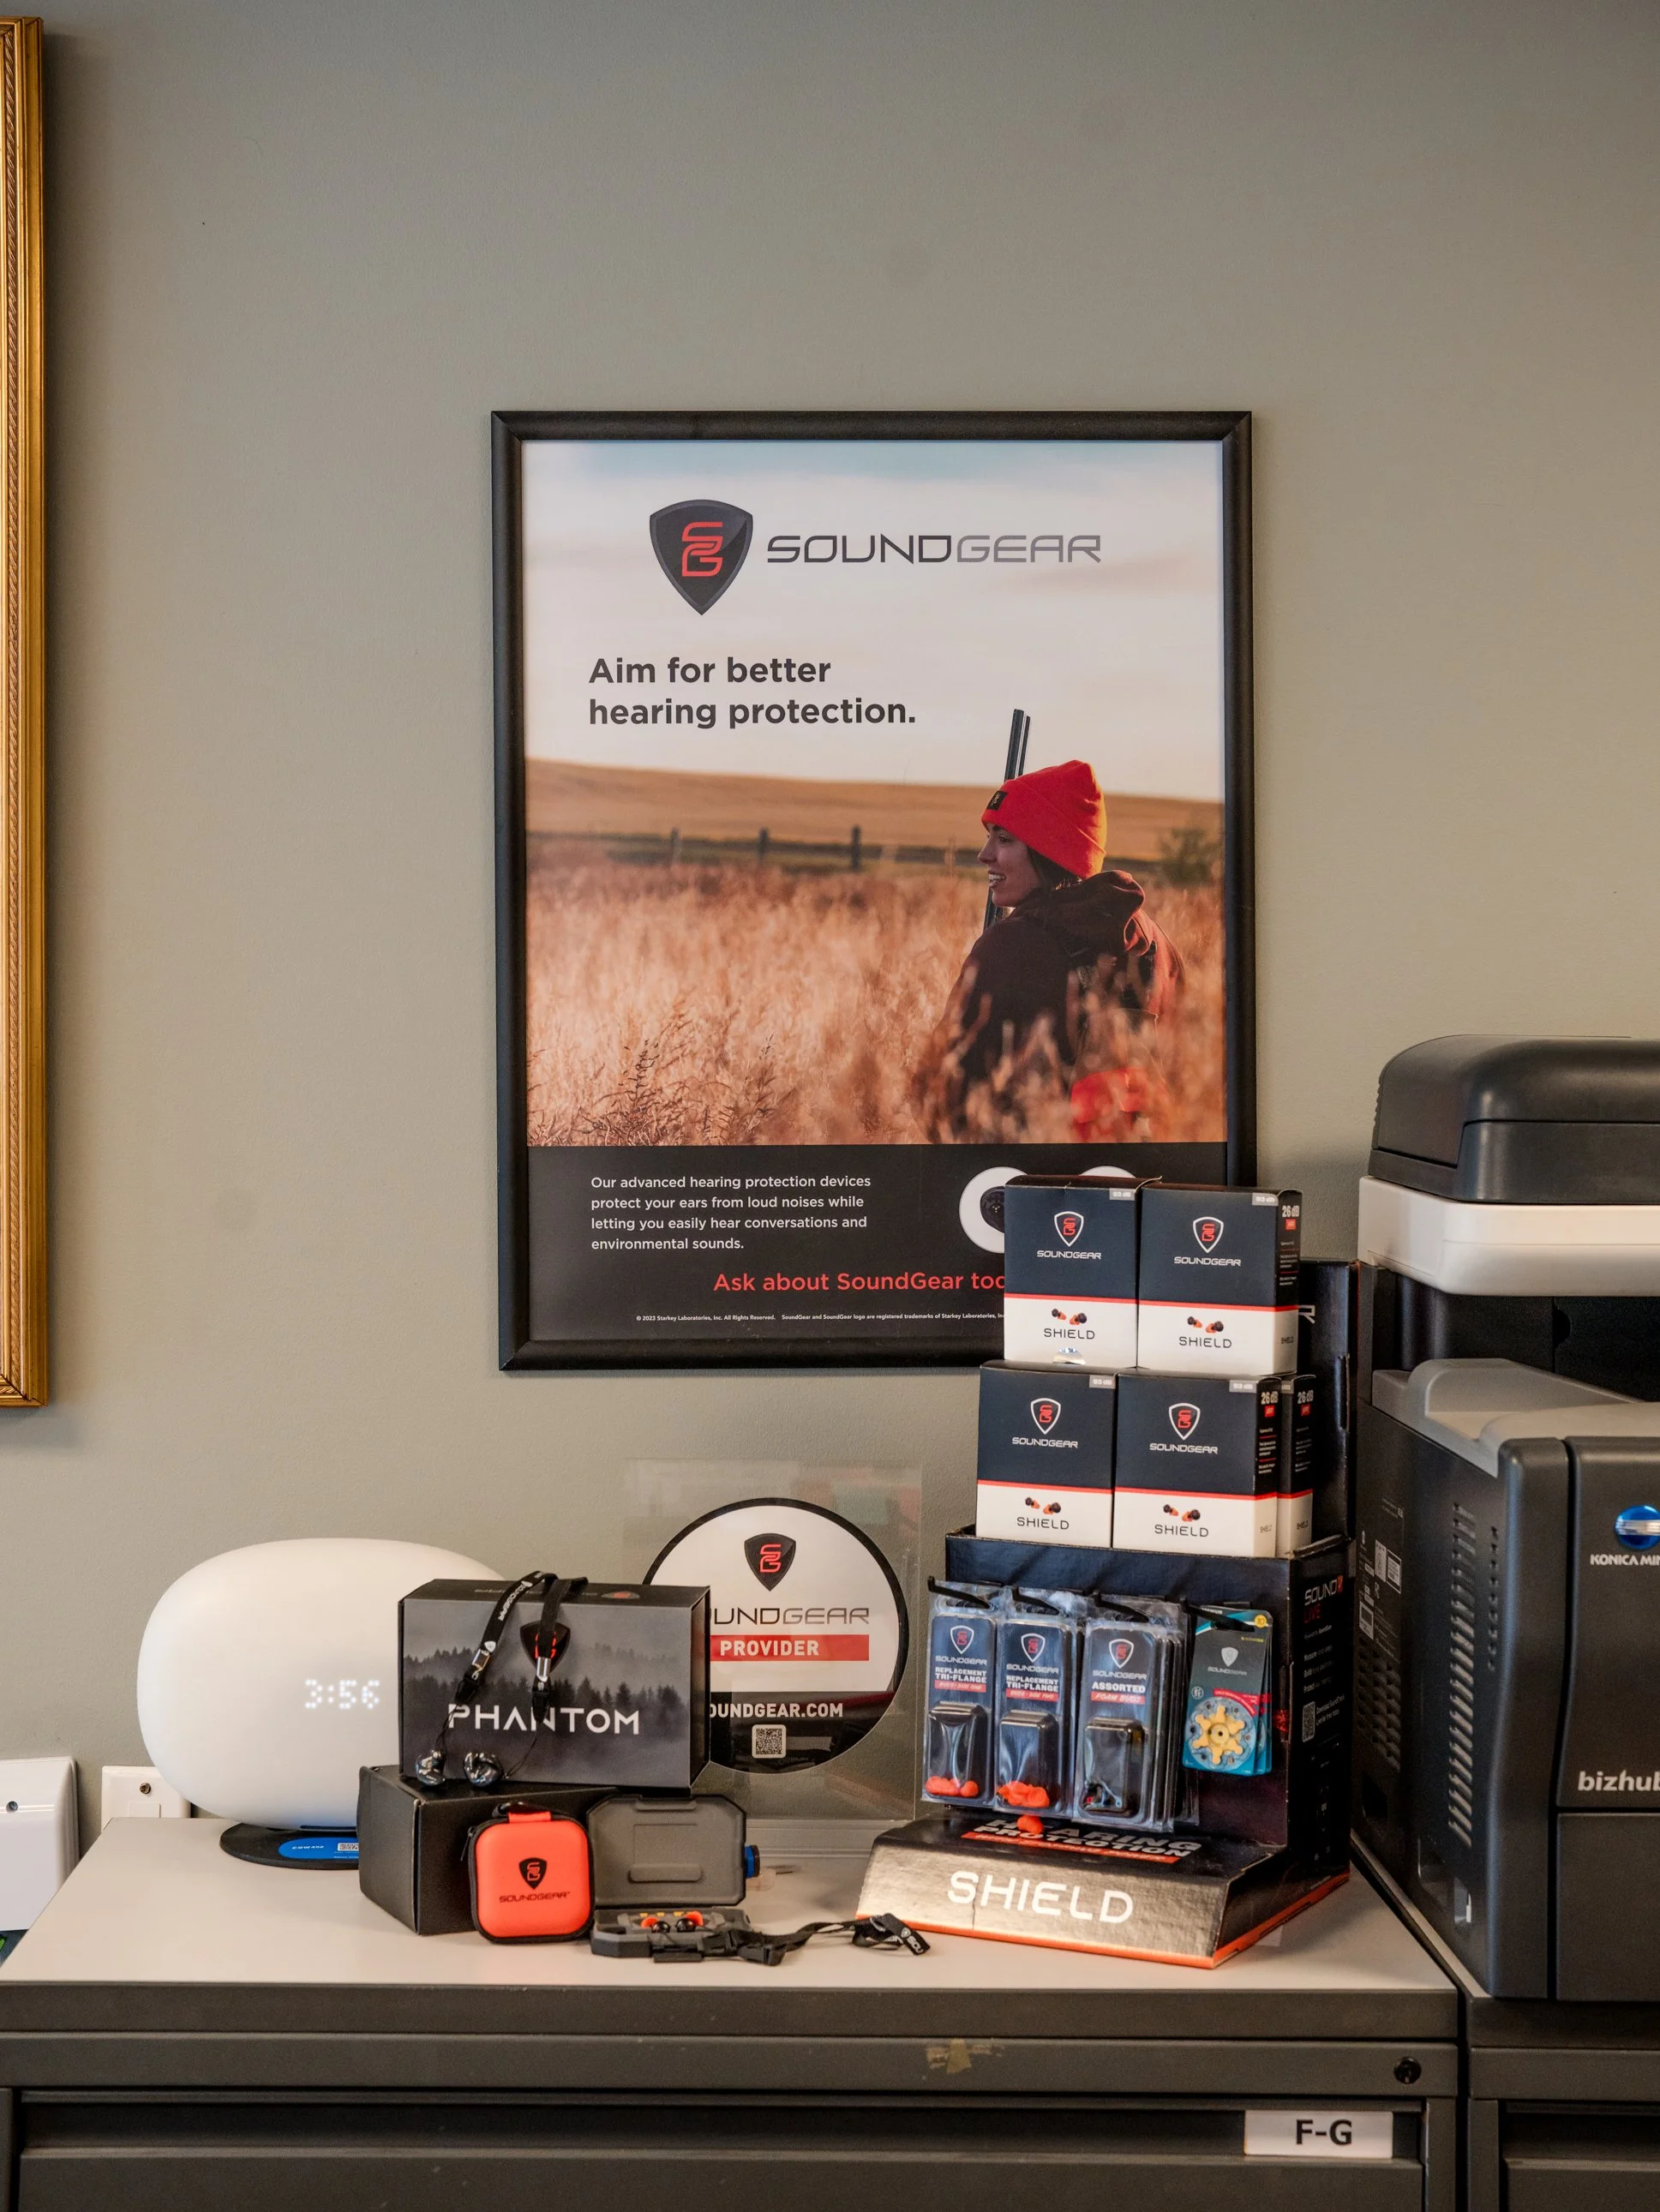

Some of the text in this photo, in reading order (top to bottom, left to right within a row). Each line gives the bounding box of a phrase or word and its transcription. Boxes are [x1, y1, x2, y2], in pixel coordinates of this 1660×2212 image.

[767, 533, 1101, 565] SOUNDGEAR
[588, 656, 831, 684] Aim for better
[590, 698, 916, 729] hearing protection.
[590, 1175, 872, 1190] Our advanced hearing protection devices
[590, 1195, 865, 1212] protect your ears from loud noises while
[1281, 1205, 1300, 1217] 26 dB
[591, 1215, 867, 1232] letting you easily hear conversations and
[590, 1237, 744, 1250] environmental sounds.
[1036, 1250, 1102, 1260] SOUNDGEAR
[1173, 1256, 1242, 1267] SOUNDGEAR
[714, 1273, 756, 1292] Ask
[762, 1273, 830, 1292] about
[837, 1271, 964, 1291] SoundGear
[656, 1314, 677, 1322] Starkey
[677, 1314, 713, 1322] Laboratories,
[853, 1313, 866, 1322] logo
[876, 1312, 903, 1322] registered
[941, 1312, 962, 1321] Starkey
[1044, 1328, 1095, 1340] SHIELD
[1178, 1335, 1232, 1349] SHIELD
[1261, 1391, 1279, 1405] 26 dB
[1297, 1392, 1306, 1405] 26
[1012, 1436, 1079, 1448] SOUNDGEAR
[1149, 1442, 1219, 1454] SOUNDGEAR
[1016, 1517, 1070, 1531] SHIELD
[1154, 1525, 1209, 1538] SHIELD
[1590, 1554, 1639, 1566] KONICA
[710, 1607, 870, 1626] UNDGEAR
[720, 1640, 819, 1657] PROVIDER
[935, 1655, 988, 1665] SOUNDGEAR
[935, 1666, 987, 1676] REPLACEMENT
[1006, 1663, 1059, 1674] SOUNDGEAR
[1092, 1669, 1148, 1680] SOUNDGEAR
[934, 1673, 987, 1683] TRI-FLANGE
[1006, 1675, 1058, 1685] REPLACEMENT
[1006, 1681, 1059, 1692] TRI-FLANGE
[1092, 1681, 1146, 1693] ASSORTED
[304, 1679, 381, 1710] 3:56
[448, 1704, 639, 1735] PHANTOM
[973, 1825, 1192, 1857] PROTECTION
[986, 1819, 1202, 1851] HARING
[499, 1892, 568, 1903] SOUNDGEAR
[947, 1871, 1134, 1925] SHIELD
[1296, 2119, 1352, 2146] F-G
